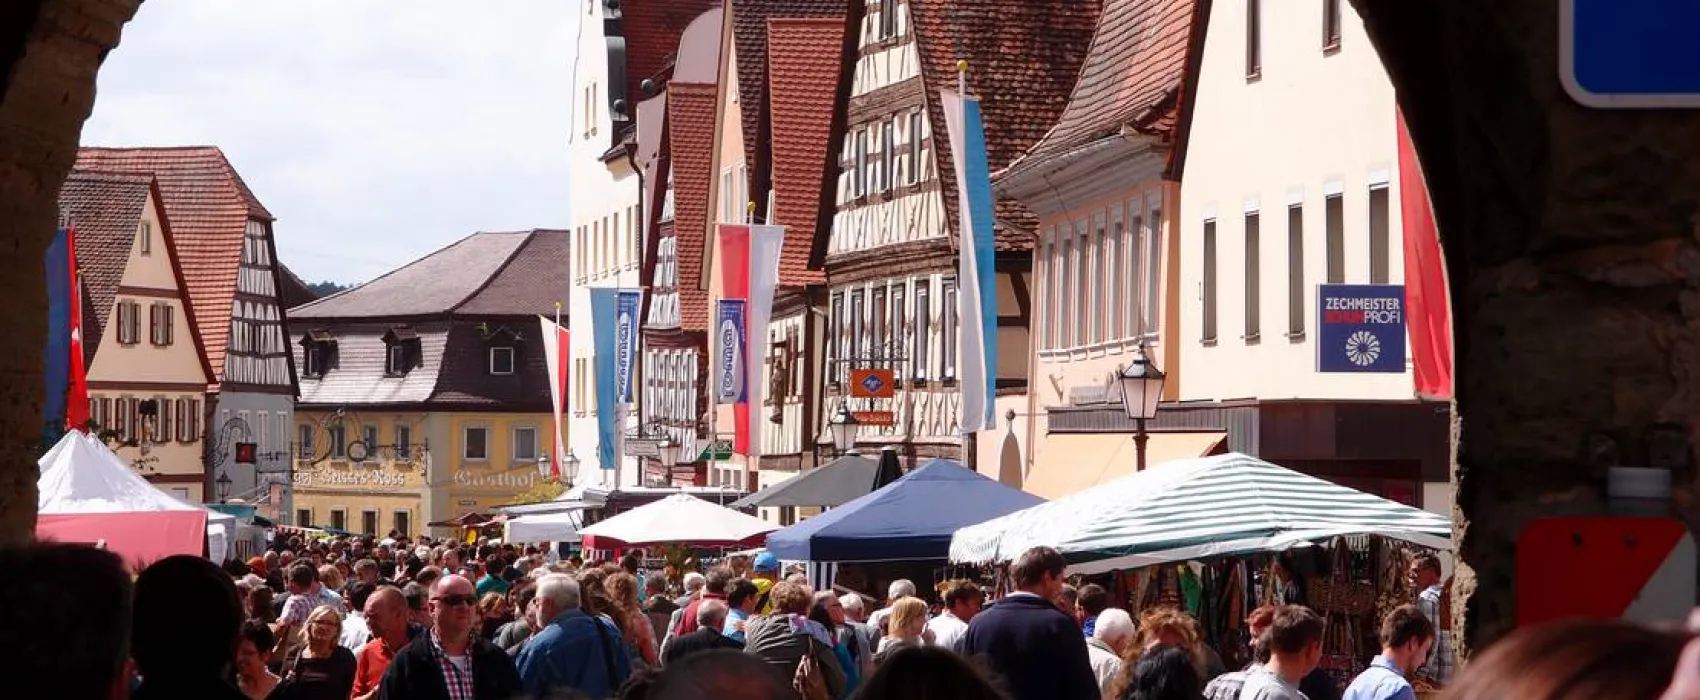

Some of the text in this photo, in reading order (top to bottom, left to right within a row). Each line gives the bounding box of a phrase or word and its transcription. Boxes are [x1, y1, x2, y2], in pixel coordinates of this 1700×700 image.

[1325, 297, 1400, 310] ZECHMEISTER
[1325, 310, 1400, 324] PROFI
[453, 469, 537, 488] Gasthof
